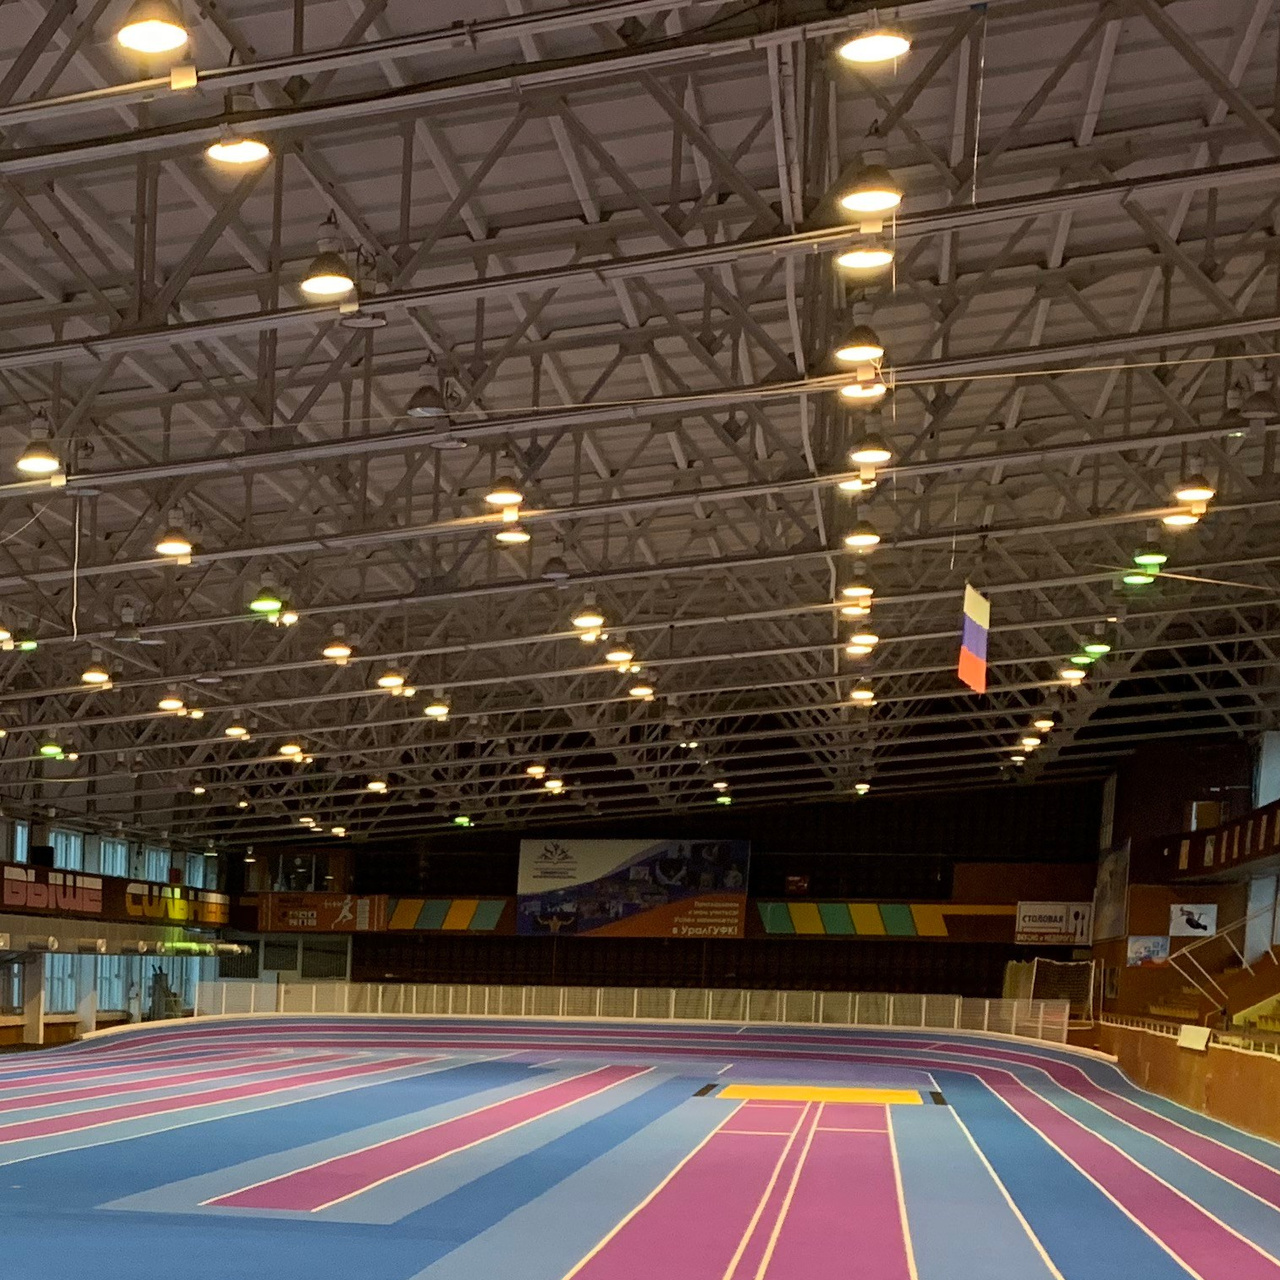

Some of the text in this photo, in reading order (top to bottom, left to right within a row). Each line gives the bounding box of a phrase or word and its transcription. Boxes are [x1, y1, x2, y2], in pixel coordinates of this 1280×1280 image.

[3, 865, 103, 913] ВЫШЕ
[125, 882, 230, 924] СИЛЬНЕЕ
[1022, 914, 1064, 923] СТОЛОВАЯ
